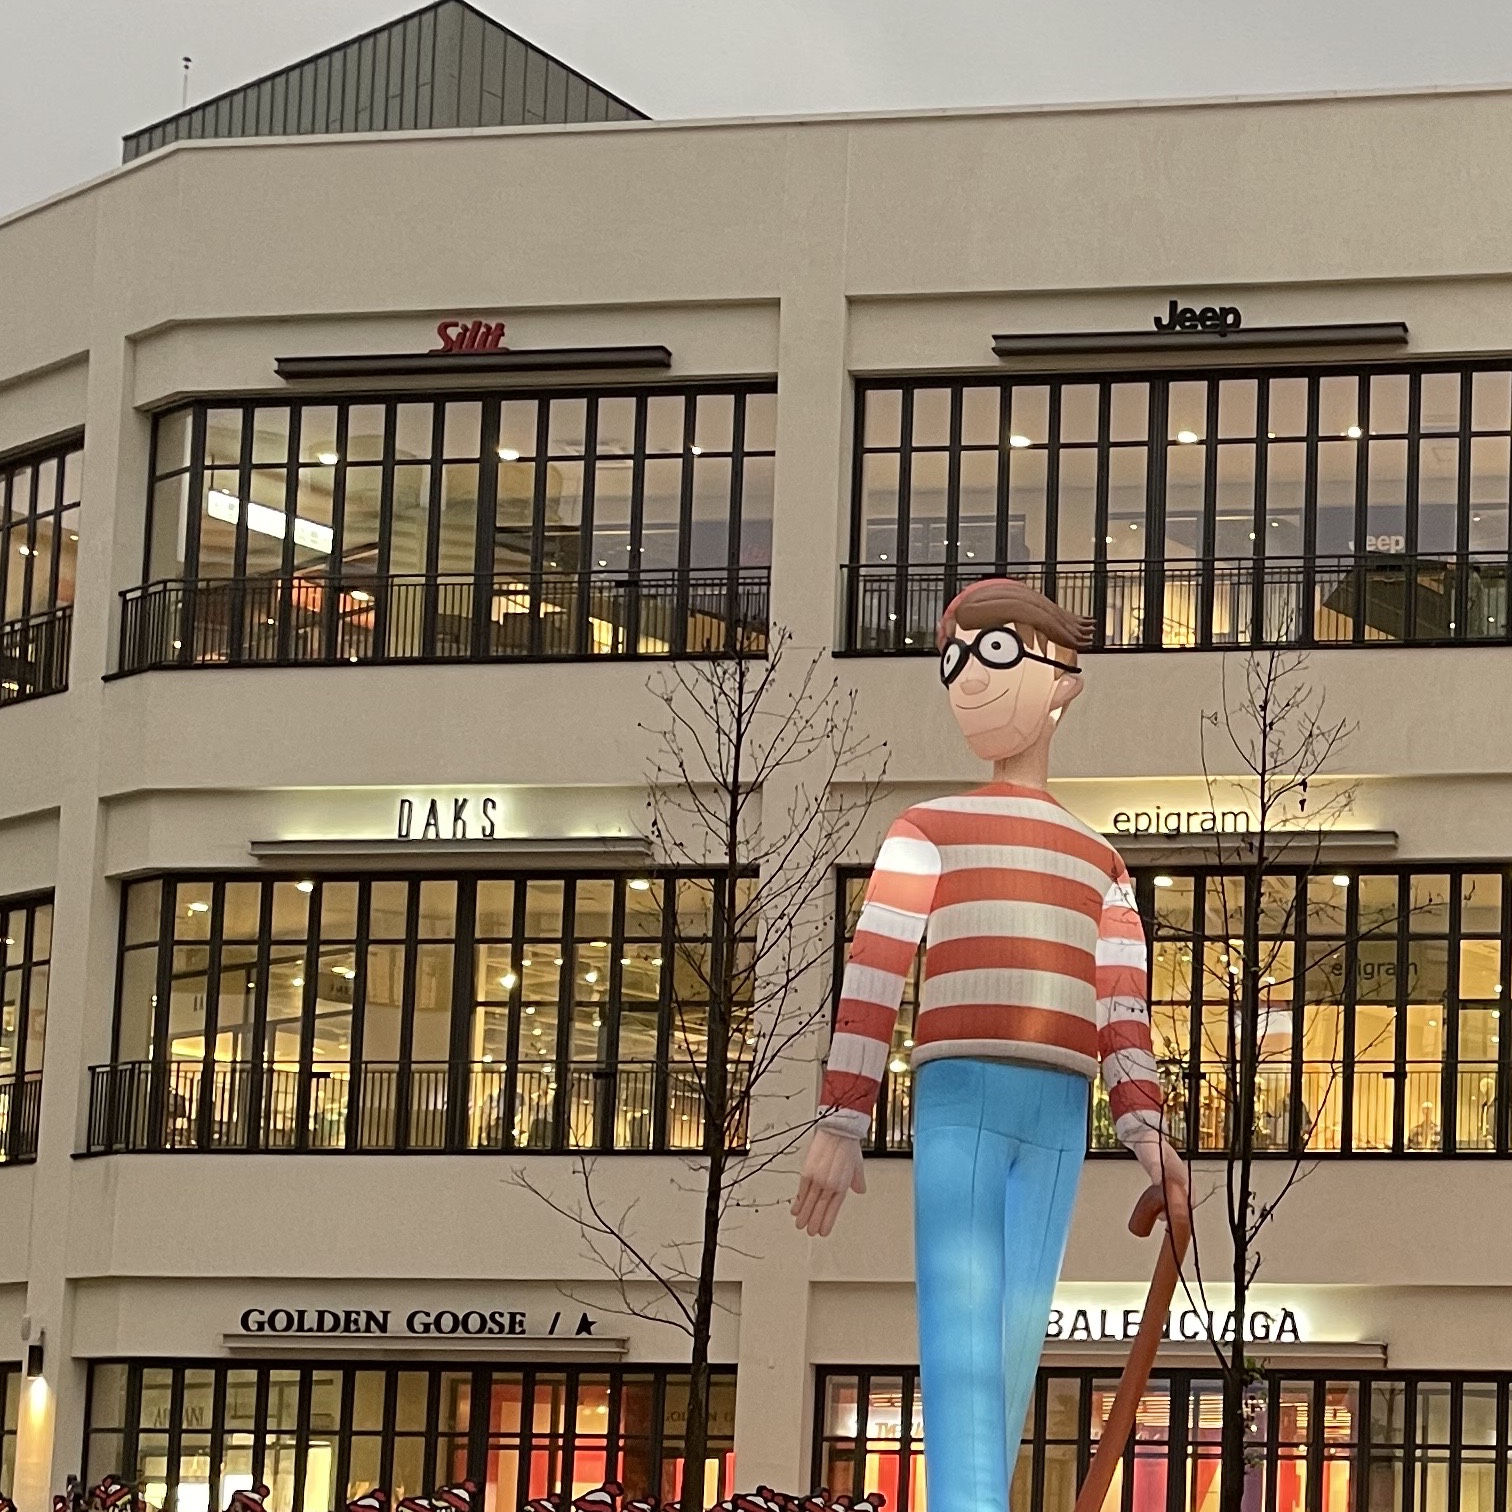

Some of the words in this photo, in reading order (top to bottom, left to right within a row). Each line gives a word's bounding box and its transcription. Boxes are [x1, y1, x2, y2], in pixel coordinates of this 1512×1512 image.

[1153, 299, 1242, 337] Jeep
[436, 320, 506, 352] Silit
[397, 797, 497, 840] DAKS
[1112, 805, 1250, 840] epigram
[1330, 961, 1418, 981] eigra
[239, 1307, 392, 1334] GOLDEN
[405, 1310, 527, 1336] GOOSE
[1046, 1307, 1300, 1342] BALECIAGA
